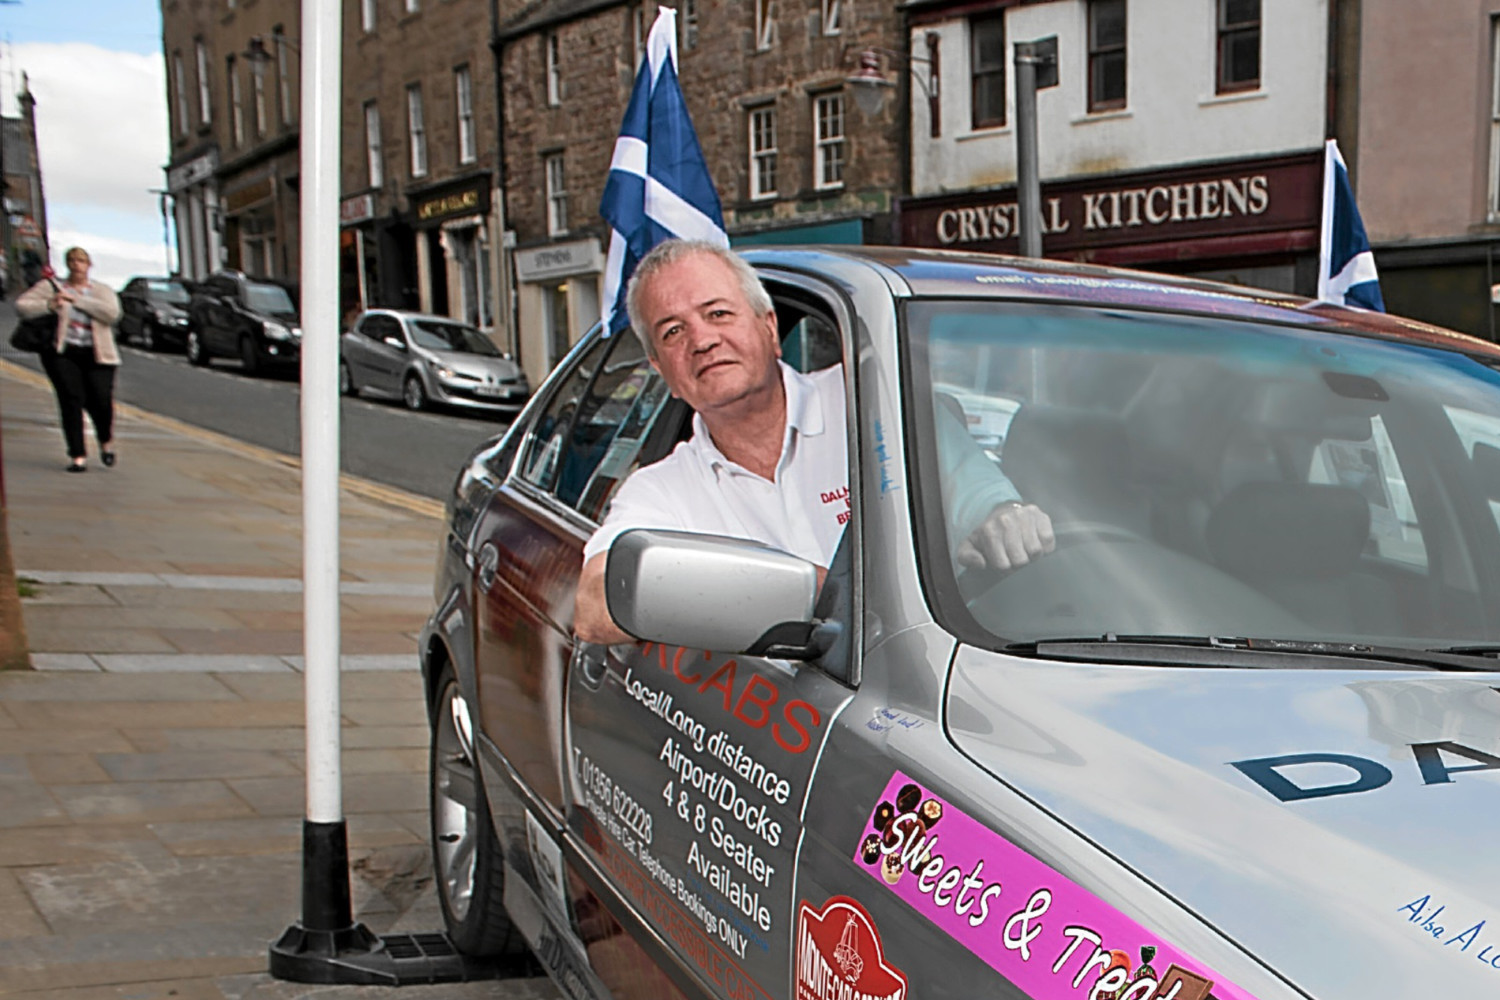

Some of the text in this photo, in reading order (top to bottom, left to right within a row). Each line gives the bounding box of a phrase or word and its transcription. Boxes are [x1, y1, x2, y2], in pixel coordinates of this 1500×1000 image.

[1082, 175, 1269, 230] KITCHENS
[625, 668, 791, 805] Local/Long distance
[583, 757, 612, 807] 01356
[613, 785, 653, 845] 622228
[660, 738, 783, 847] Airport/Docks
[663, 781, 775, 889] 4 & 8 Seater
[637, 840, 677, 895] Telephone
[677, 878, 717, 934] Bookings
[718, 917, 748, 960] ONLY
[644, 890, 723, 987] ACCESSIBLE
[686, 840, 771, 932] Available
[880, 812, 1001, 928] Sweets
[1003, 887, 1053, 962] &
